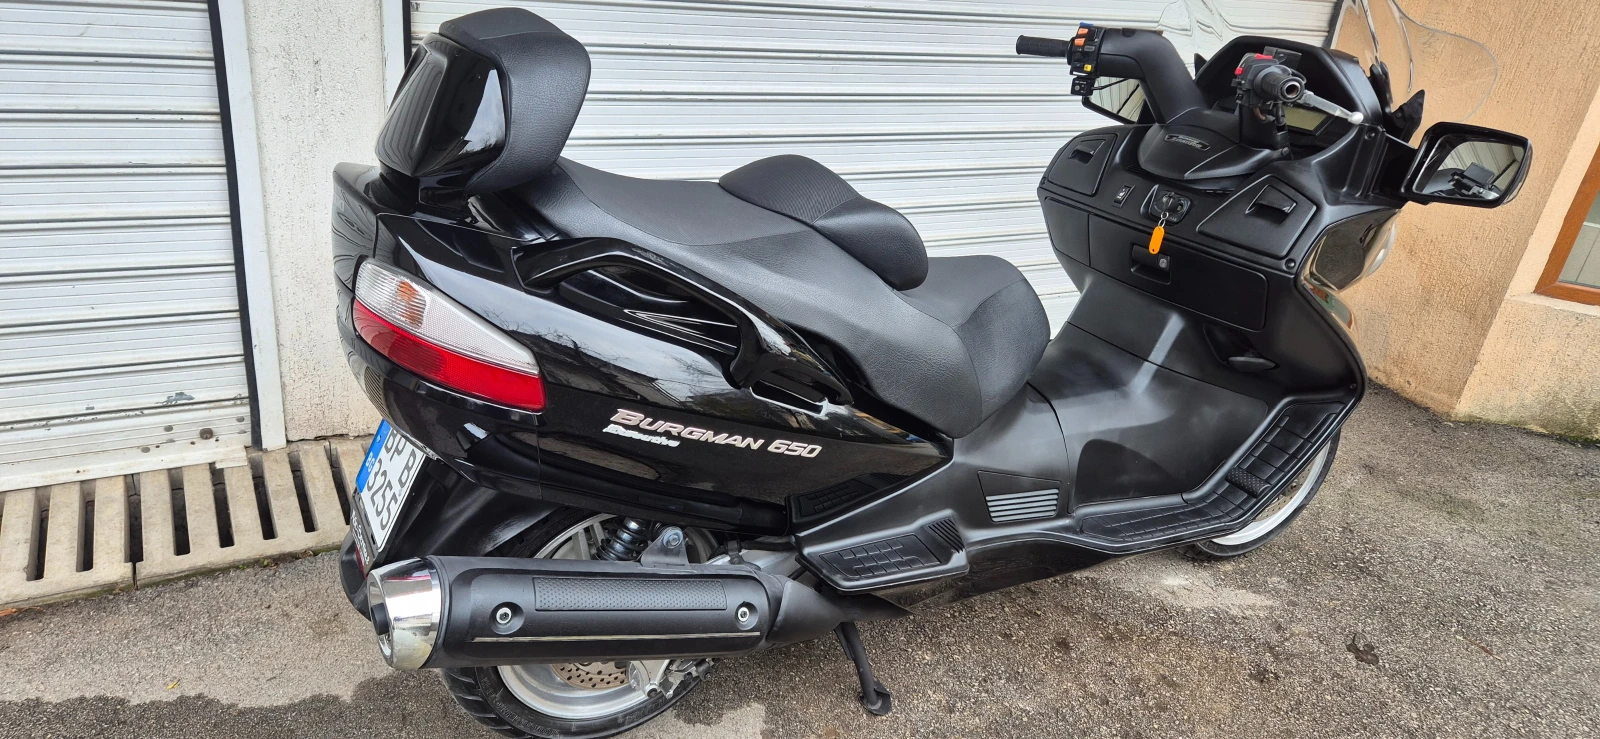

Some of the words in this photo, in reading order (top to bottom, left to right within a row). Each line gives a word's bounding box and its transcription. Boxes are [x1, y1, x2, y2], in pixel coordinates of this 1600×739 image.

[384, 429, 407, 462] BP
[398, 449, 417, 489] B
[610, 408, 764, 450] BURGMAN
[767, 439, 822, 458] 650
[365, 452, 376, 473] BG
[366, 457, 399, 531] 3255
